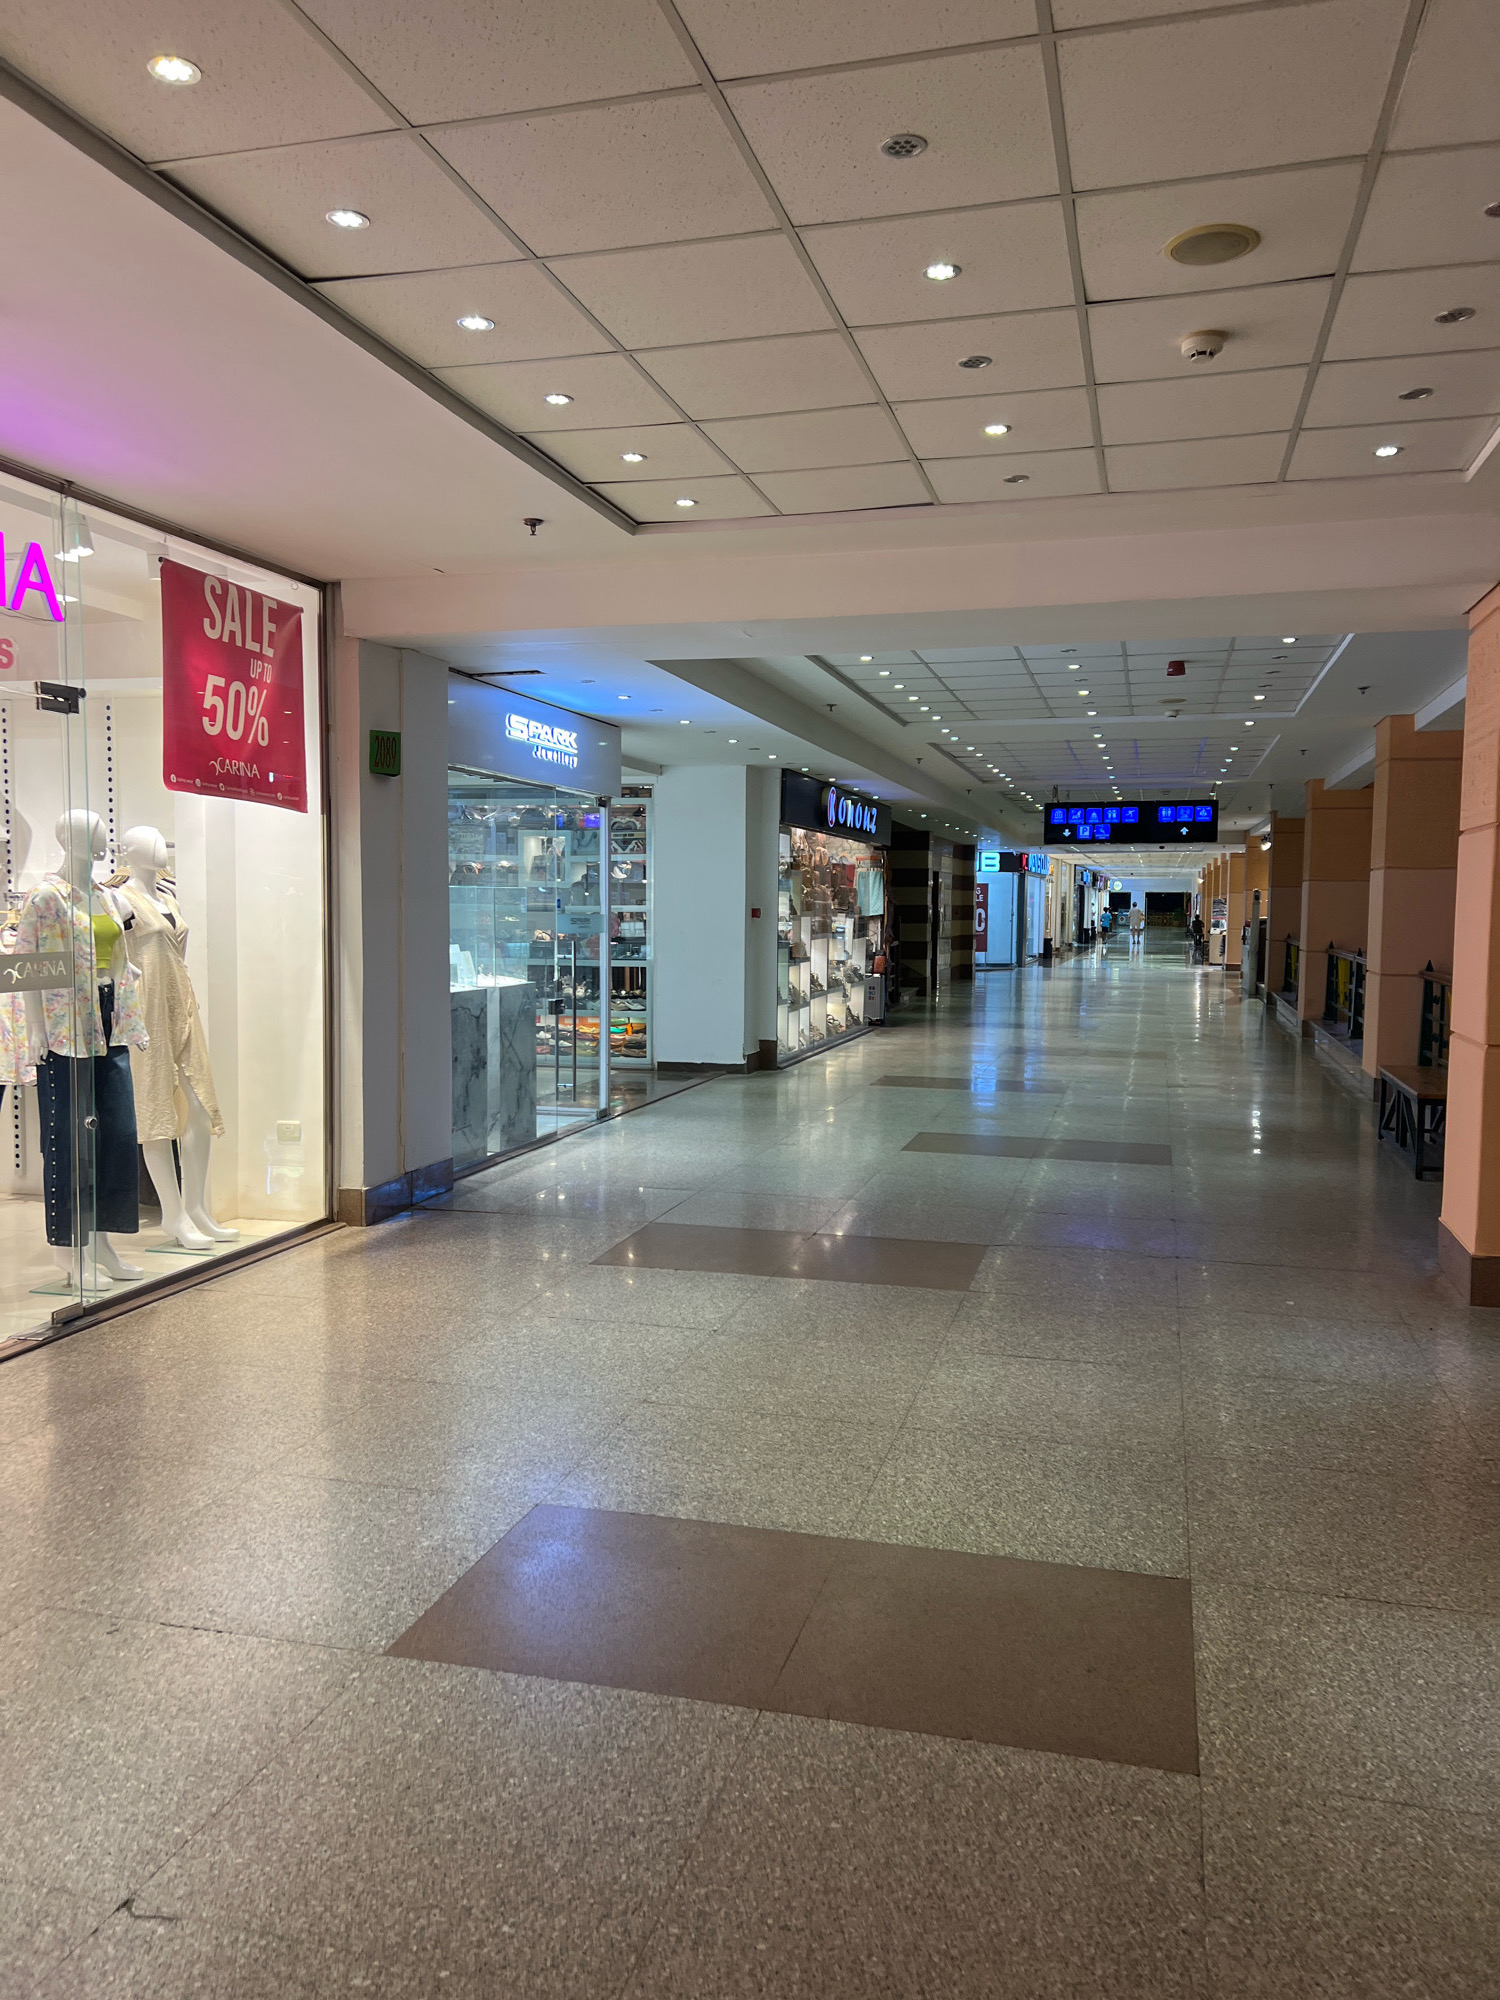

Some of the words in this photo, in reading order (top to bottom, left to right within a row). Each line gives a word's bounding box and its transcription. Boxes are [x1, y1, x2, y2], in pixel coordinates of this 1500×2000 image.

[203, 575, 278, 658] SALE
[250, 658, 262, 680] UP
[264, 663, 272, 684] TO
[202, 674, 269, 747] 50%
[505, 713, 578, 750] SPARK
[374, 735, 396, 768] 2089
[216, 757, 260, 780] CARINA
[976, 852, 1000, 872] B
